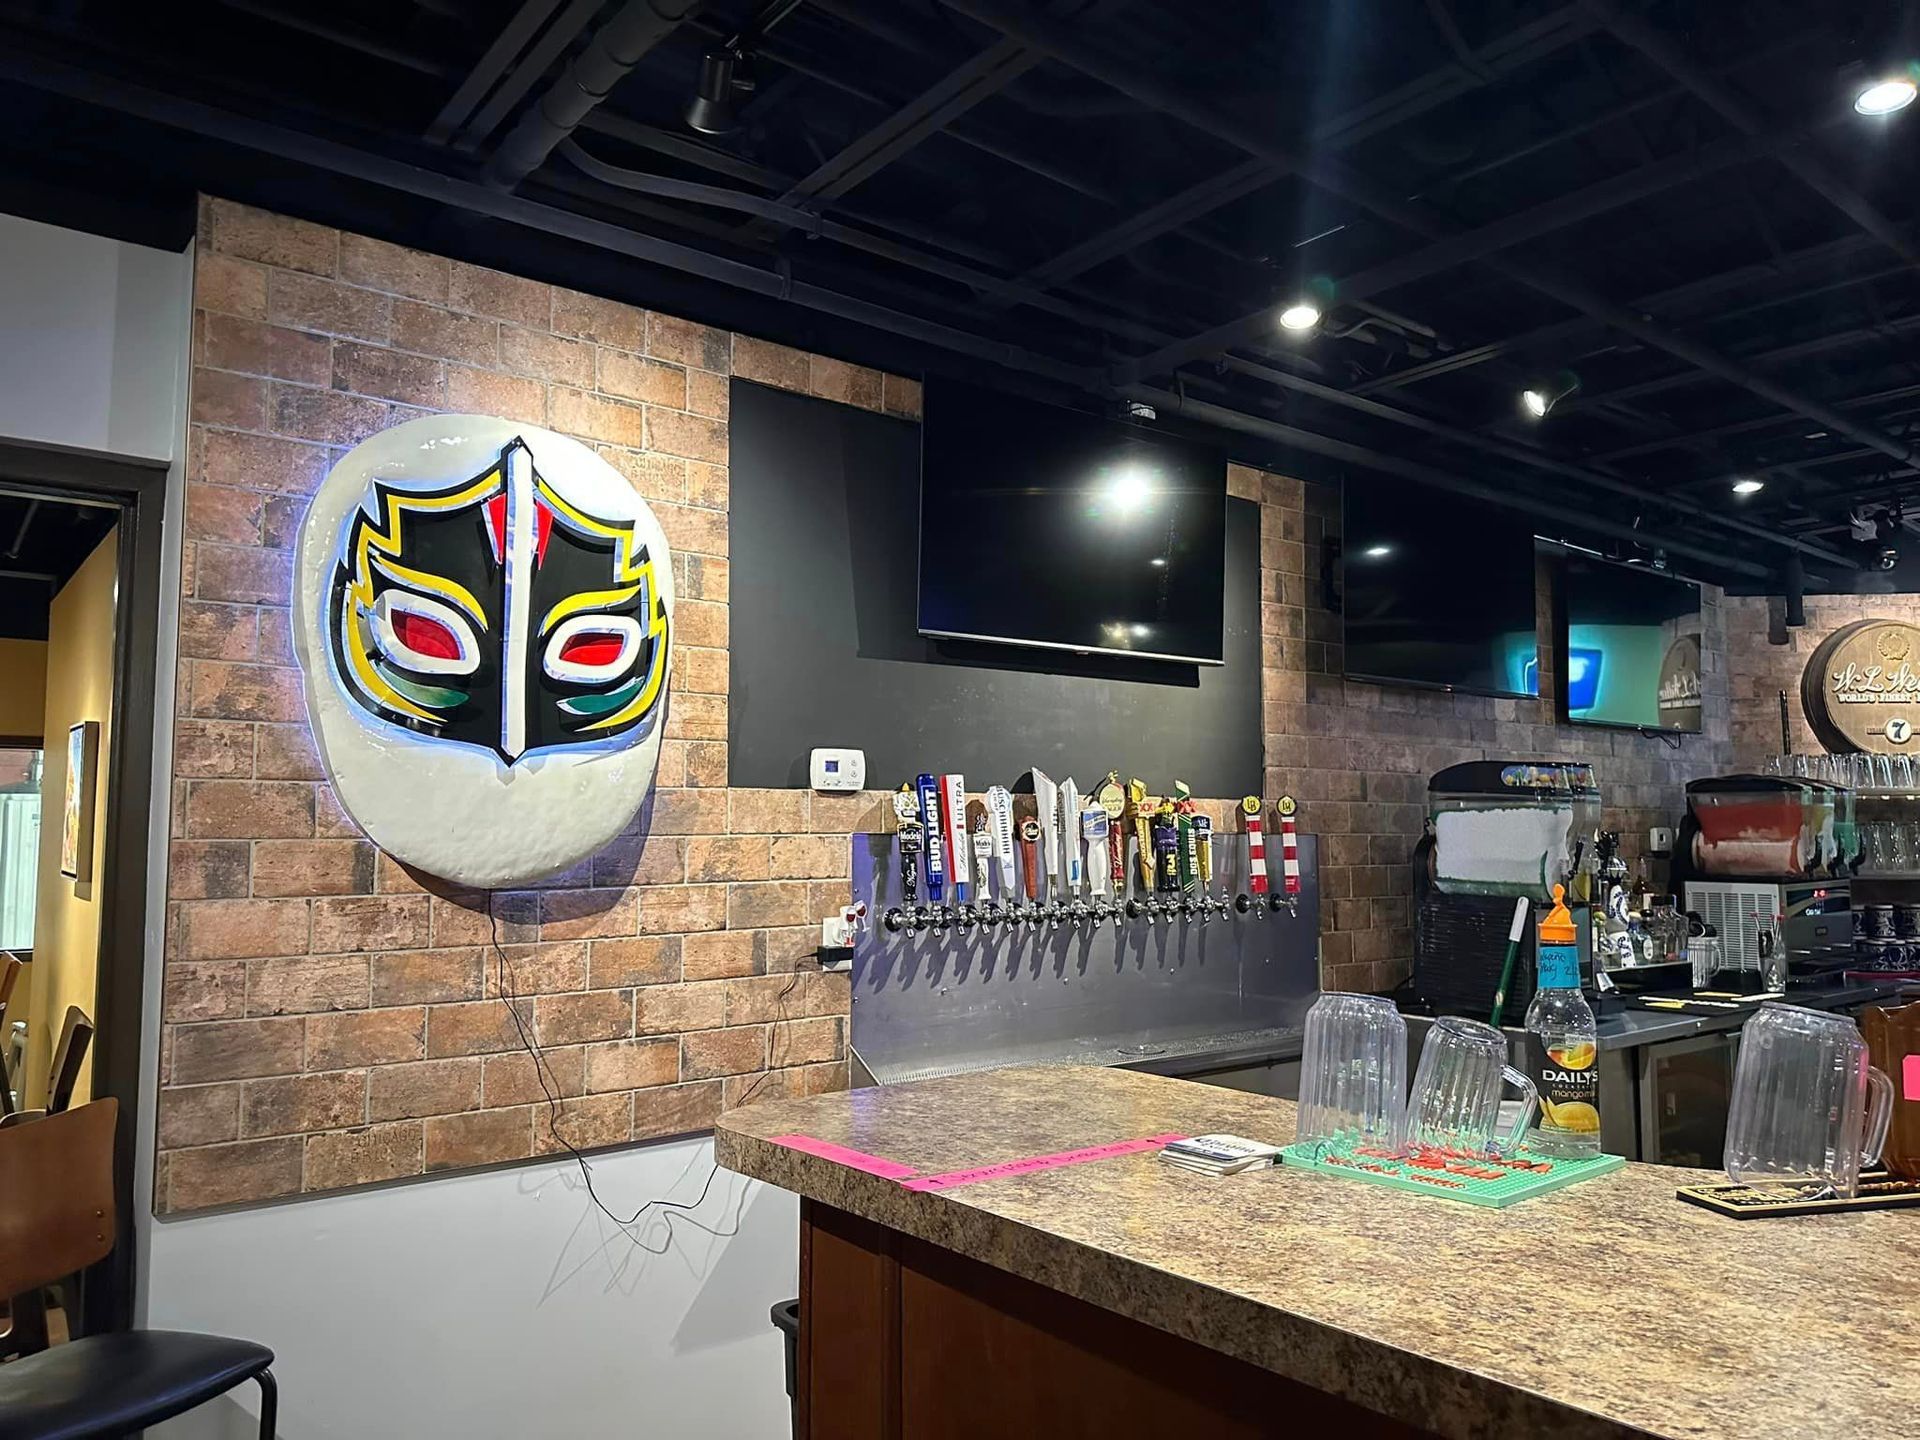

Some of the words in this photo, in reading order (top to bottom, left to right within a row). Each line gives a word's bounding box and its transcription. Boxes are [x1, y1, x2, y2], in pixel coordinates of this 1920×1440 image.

[1892, 722, 1905, 739] 7
[956, 781, 965, 821] ULTRA
[1139, 802, 1153, 812] XX
[1180, 801, 1197, 813] XX
[925, 789, 940, 836] LIGHT
[1188, 828, 1197, 855] EQUIS
[930, 838, 942, 872] BUD
[1189, 859, 1197, 875] DOS
[1552, 1089, 1584, 1099] mango
